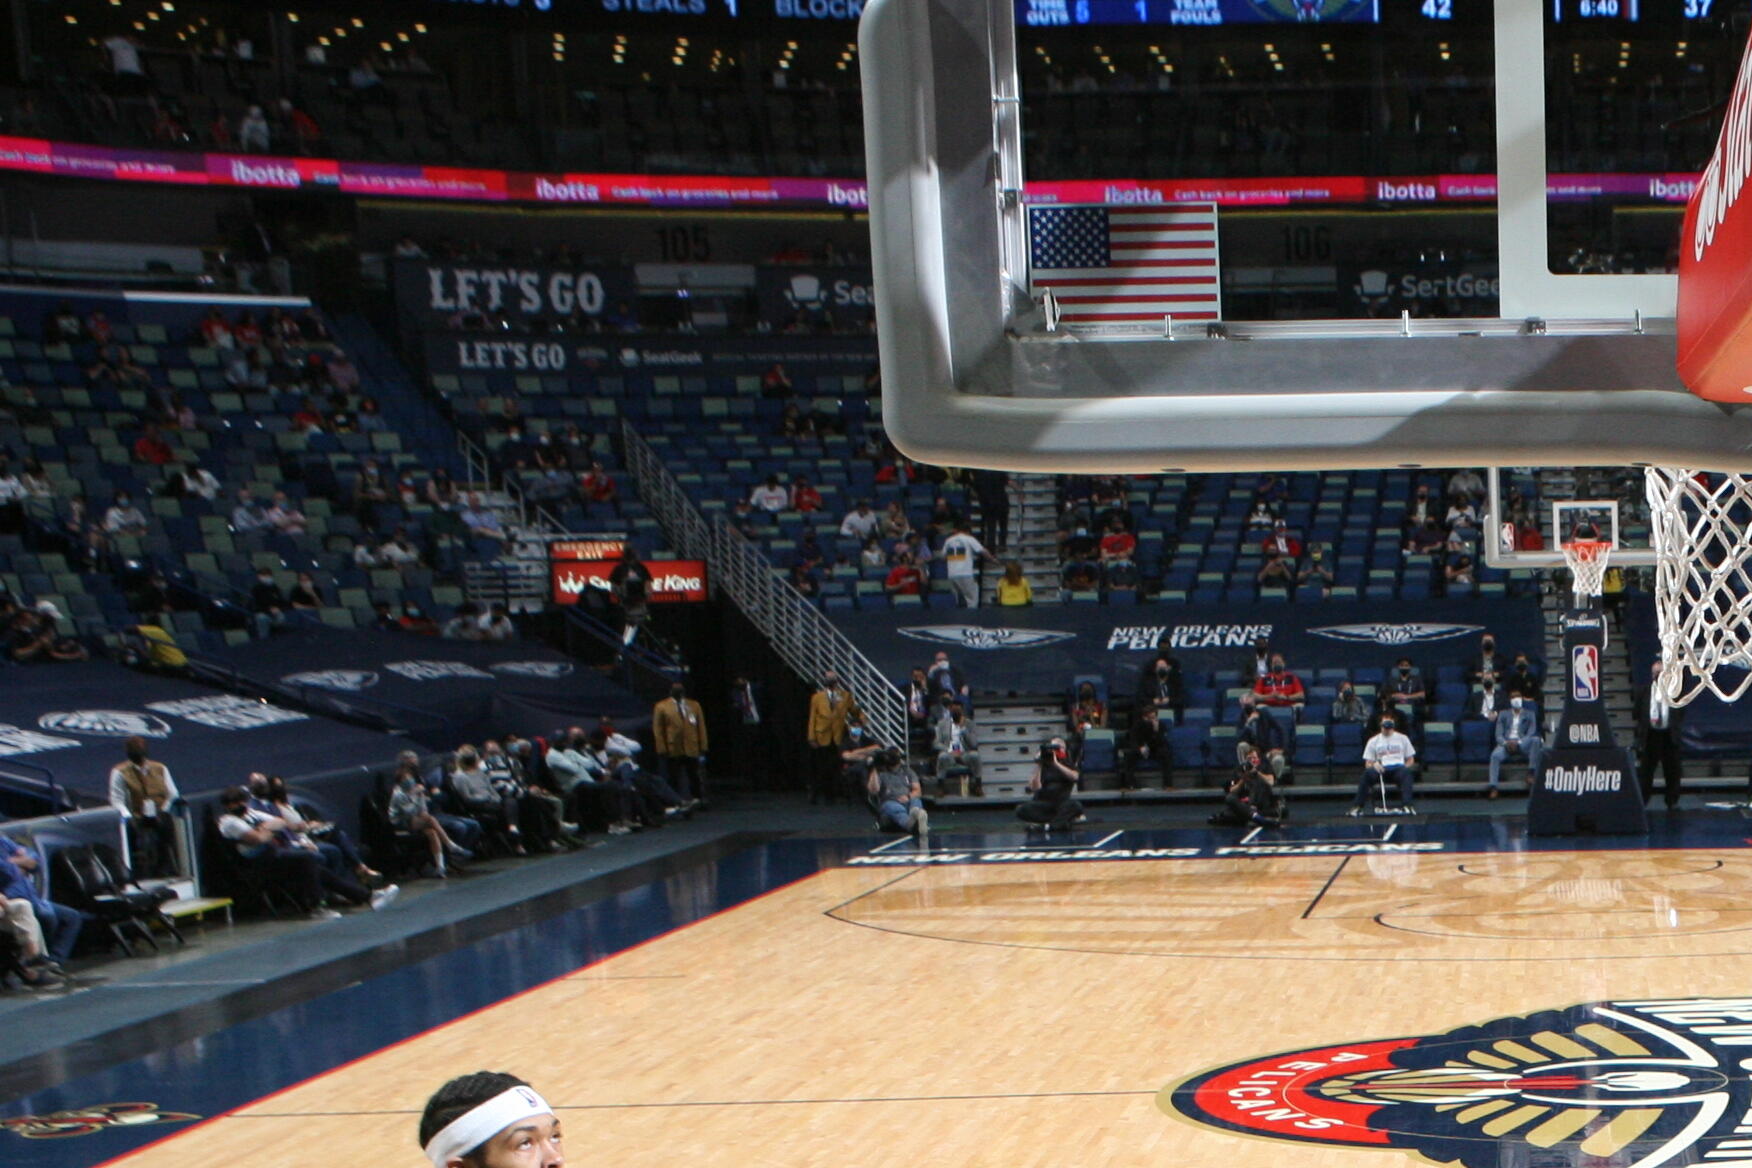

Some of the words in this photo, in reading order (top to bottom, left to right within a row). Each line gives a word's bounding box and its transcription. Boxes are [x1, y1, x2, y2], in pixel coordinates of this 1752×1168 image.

[1026, 9, 1070, 25] OUTS
[1170, 9, 1222, 24] FOULS
[1421, 0, 1453, 19] 42
[231, 160, 302, 188] ibotta
[535, 177, 601, 201] ibotta
[1105, 185, 1164, 204] ibotta
[1377, 181, 1436, 201] ibotta
[656, 226, 711, 262] 105
[428, 268, 541, 314] LET'S
[549, 269, 605, 315] GO
[457, 341, 528, 369] LET'S
[531, 343, 566, 370] GO
[553, 541, 625, 552] EMERGENCY
[1112, 625, 1168, 639] NEW
[1173, 623, 1273, 638] ORLEANS
[1568, 723, 1600, 744] @NBA
[1544, 765, 1622, 796] #OnlyHere
[847, 852, 967, 866] NEW
[974, 847, 1201, 862] ORLEANS
[1215, 841, 1446, 856] PELICANS
[1227, 1051, 1370, 1130] PELICANS
